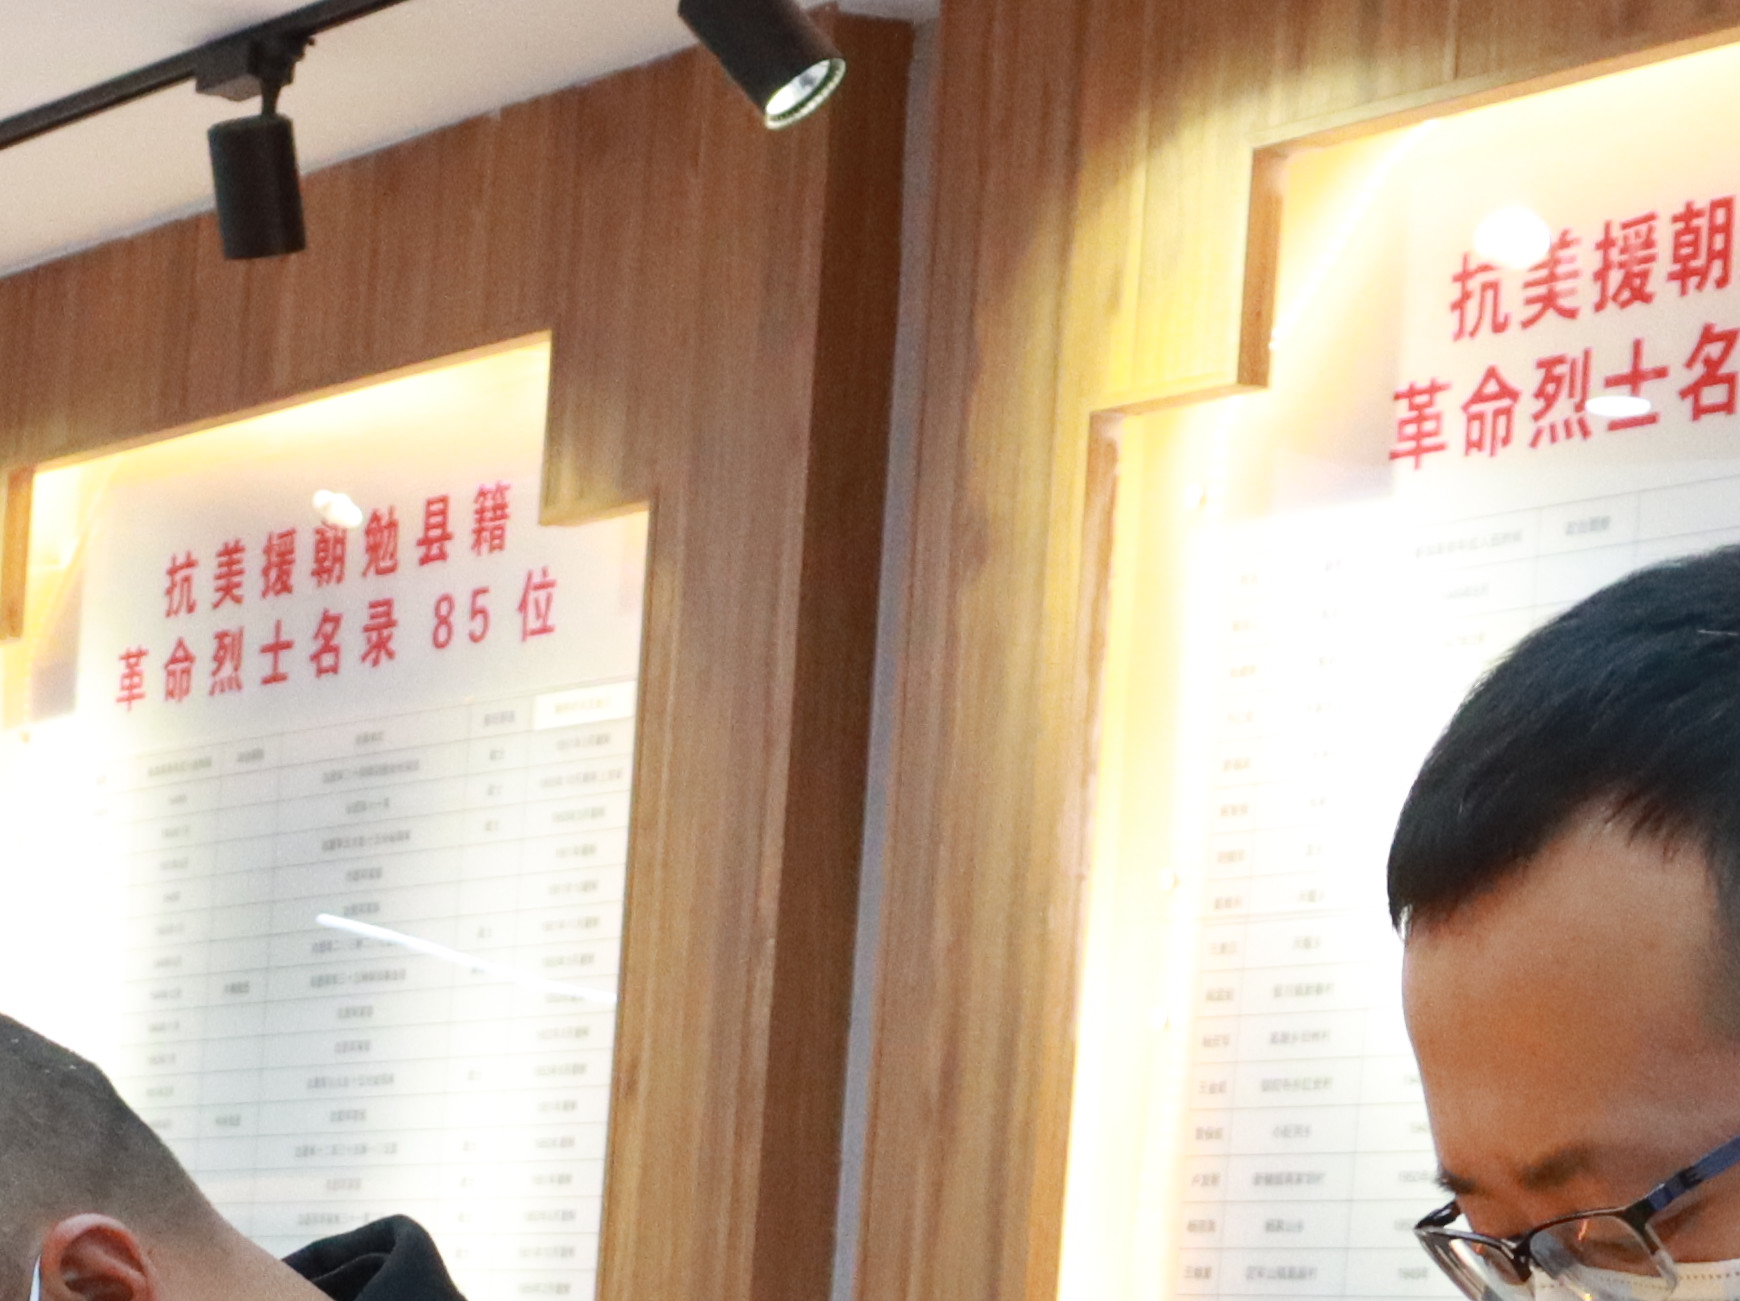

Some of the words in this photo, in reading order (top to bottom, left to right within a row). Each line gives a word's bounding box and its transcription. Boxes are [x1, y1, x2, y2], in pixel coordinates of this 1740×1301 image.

[162, 478, 514, 620] 抗美援朝勉县籍
